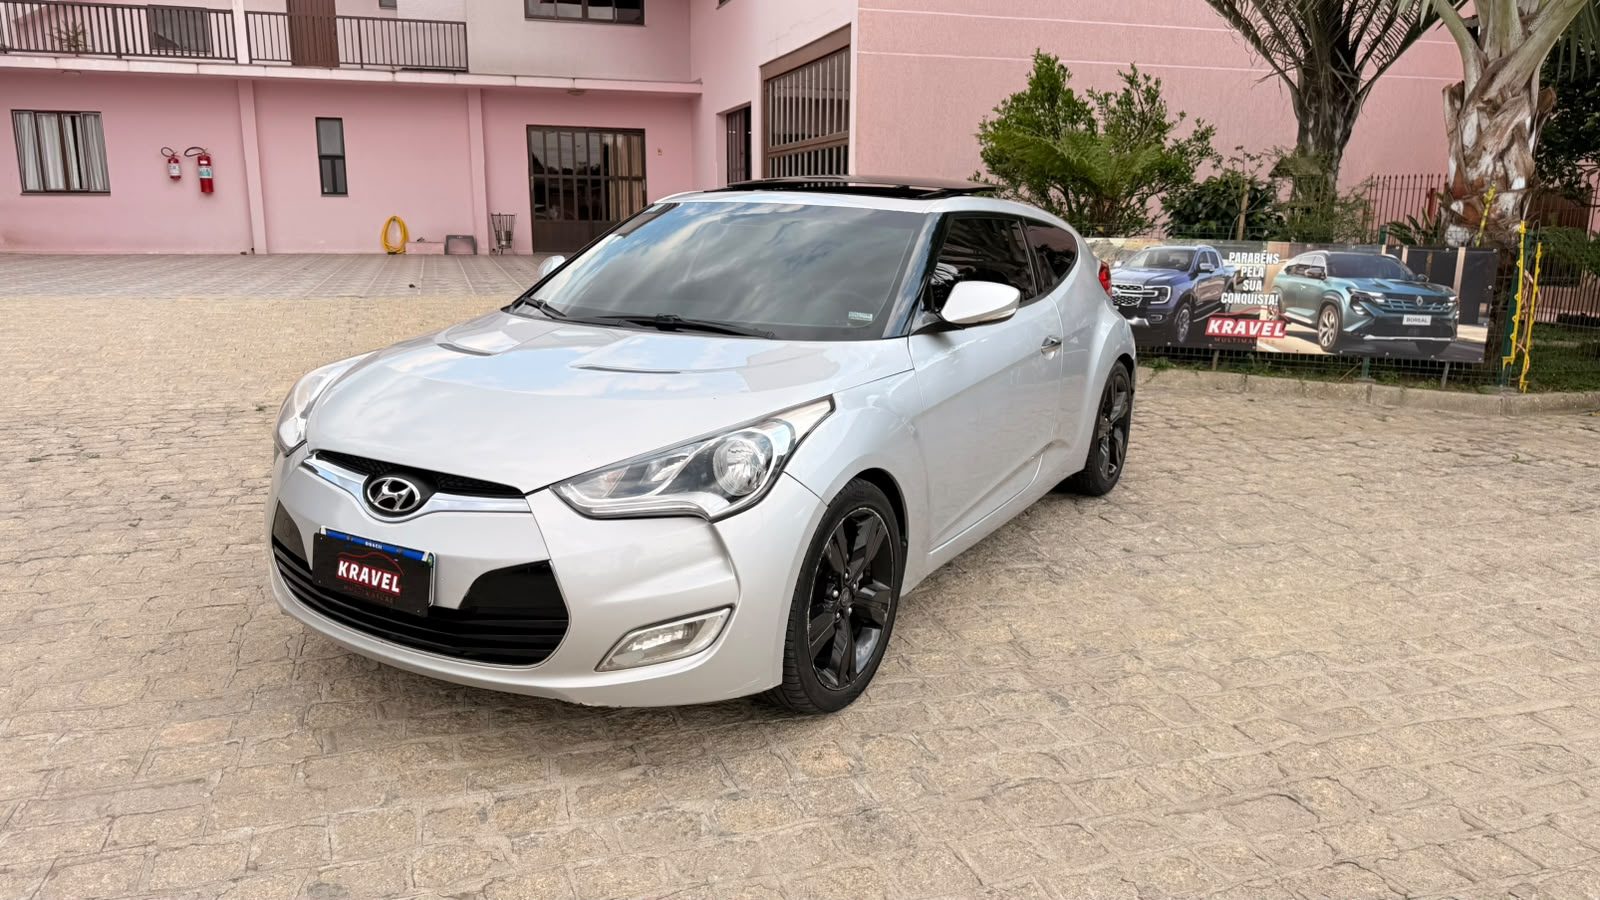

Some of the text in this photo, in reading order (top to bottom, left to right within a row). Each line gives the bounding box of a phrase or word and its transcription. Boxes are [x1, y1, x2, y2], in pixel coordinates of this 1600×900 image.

[1228, 250, 1280, 265] PARABÉNS
[1240, 265, 1265, 278] PELA
[1242, 279, 1263, 291] SUA
[1221, 292, 1279, 305] CONQUISTA!
[1207, 319, 1285, 337] KRAVEL
[338, 560, 400, 593] KRAVEL
